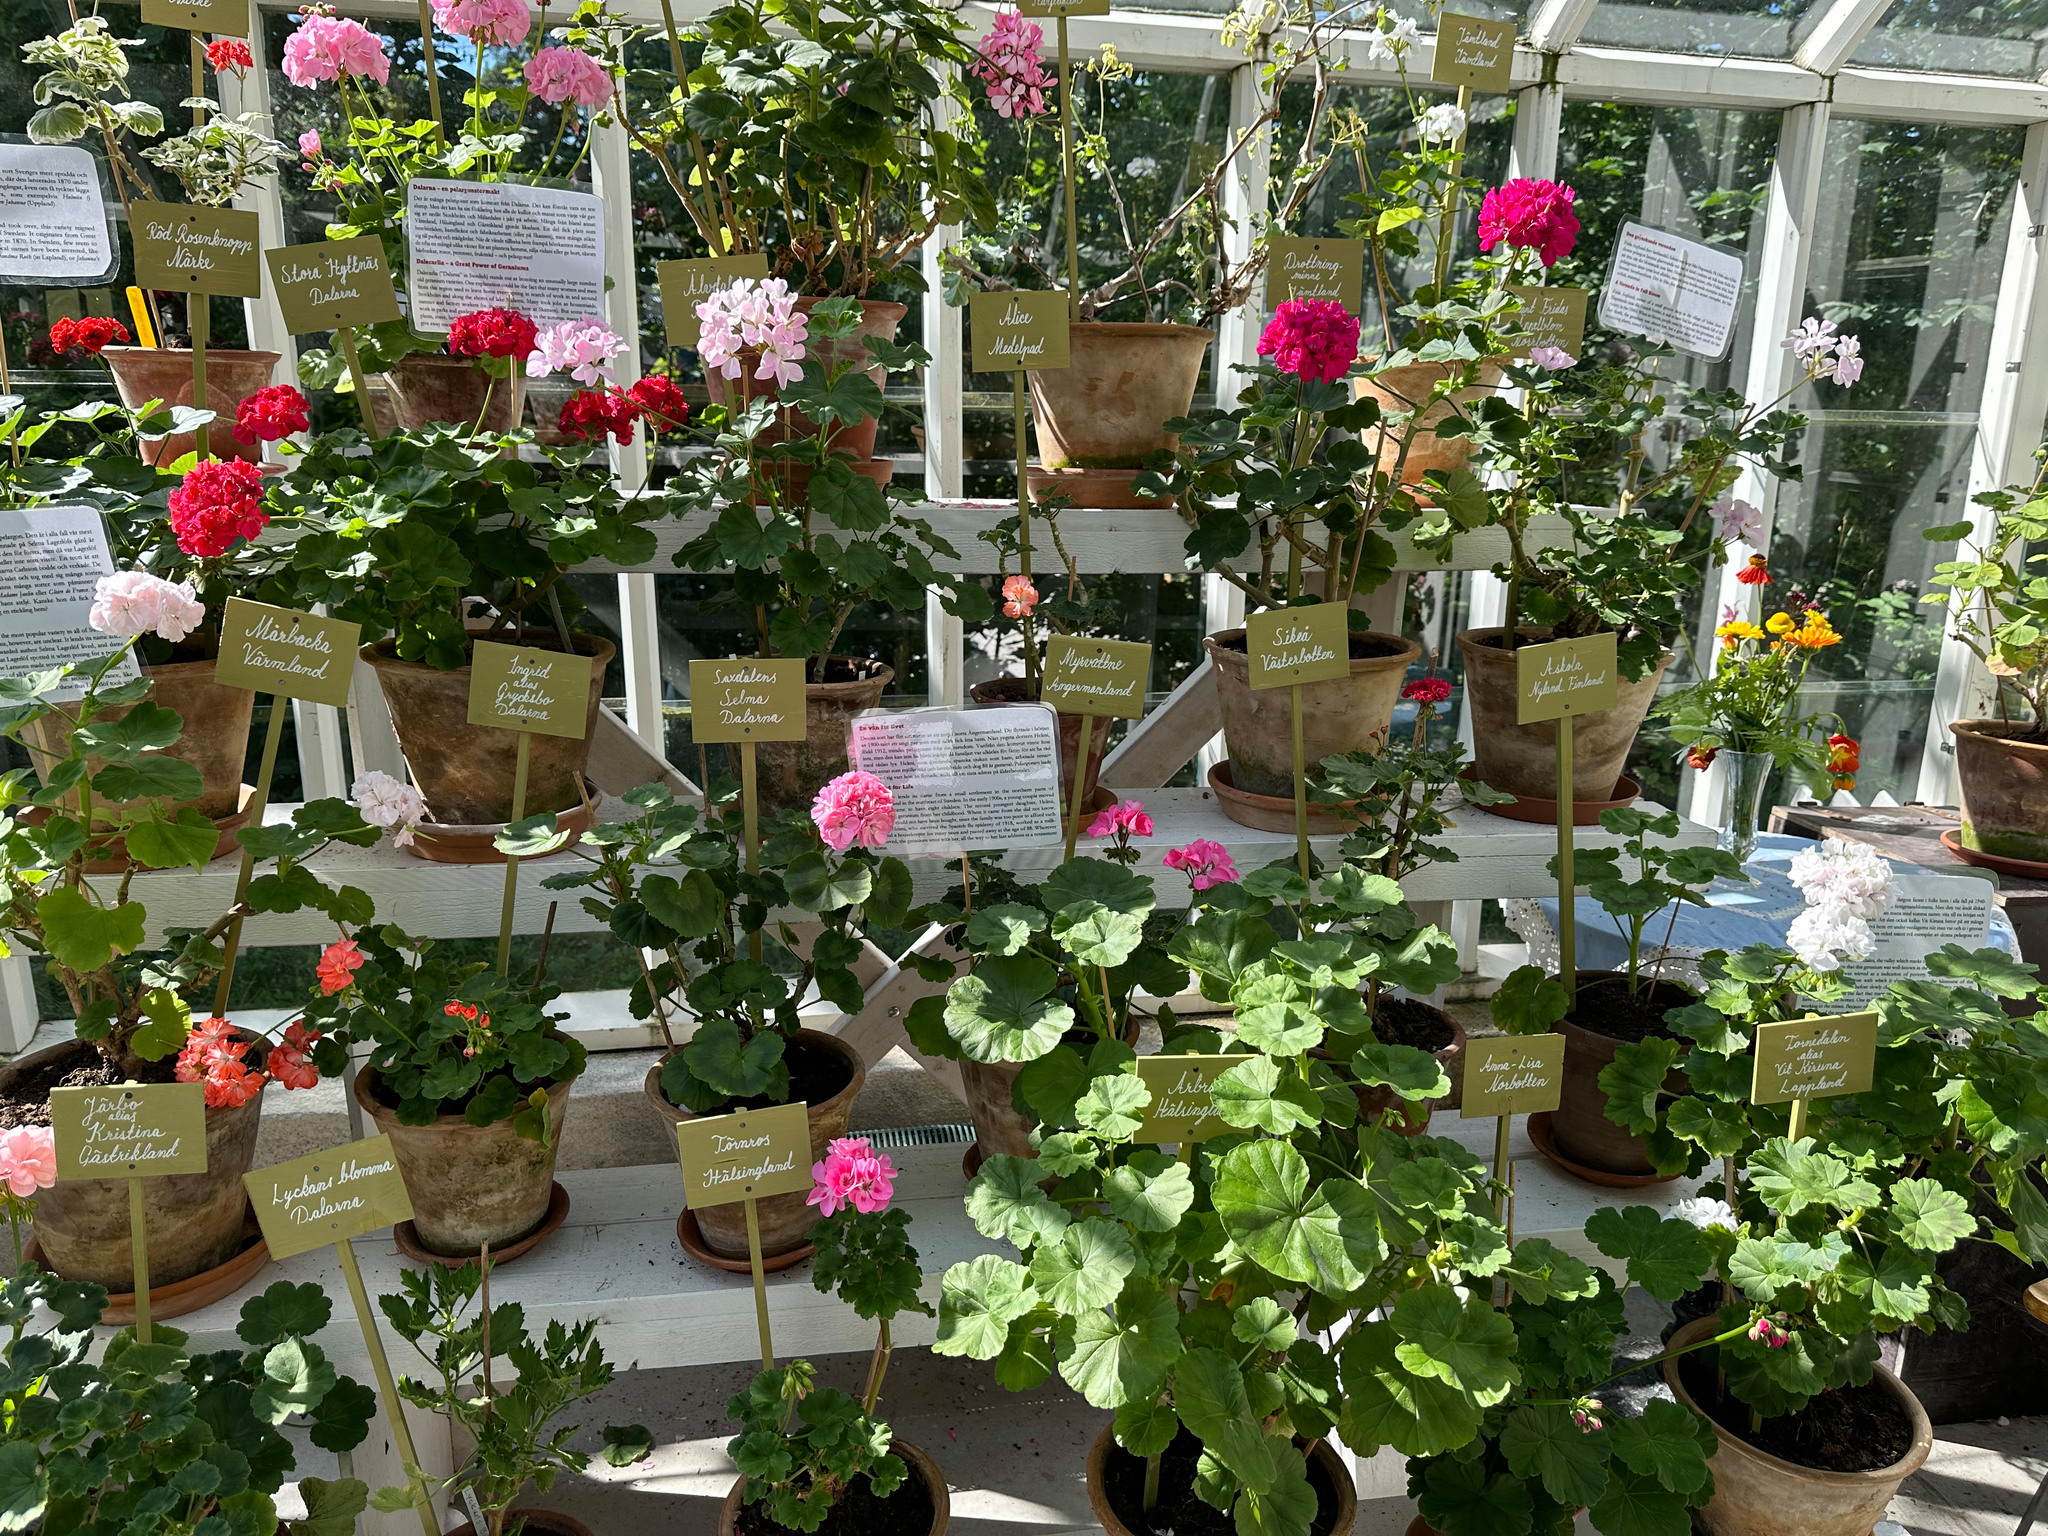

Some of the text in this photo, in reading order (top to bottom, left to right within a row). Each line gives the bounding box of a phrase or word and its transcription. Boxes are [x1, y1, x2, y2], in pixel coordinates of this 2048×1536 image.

[1456, 27, 1502, 48] Jämtland
[1454, 48, 1498, 67] Jämtland
[146, 222, 253, 255] Röd Rosenknopp
[167, 246, 215, 270] Närke
[1284, 252, 1343, 280] Drottning-
[282, 255, 378, 285] Stora Hyttnäs
[1291, 270, 1320, 280] minne
[684, 269, 733, 296] Älvdal
[310, 286, 360, 306] Dalarna
[1540, 298, 1568, 315] Fridas
[1000, 303, 1033, 326] Alice
[988, 335, 1044, 361] Medelpad
[1511, 333, 1568, 348] Norrbotten
[245, 614, 332, 654] Mårbacka
[1273, 626, 1313, 646] Sikeå
[57, 643, 79, 651] Lagerlöf
[70, 650, 91, 658] posing
[1261, 645, 1335, 671] Västerbotten
[242, 642, 330, 680] Värmland
[507, 655, 552, 683] Ingrid
[1540, 654, 1583, 677] Askola
[513, 678, 538, 690] alias
[714, 668, 776, 684] Saxdalens
[1047, 670, 1136, 698] Ångermanland
[1568, 670, 1606, 690] Finland
[496, 682, 554, 707] Grycksbo
[720, 688, 770, 706] Selma
[494, 703, 551, 720] Dalarna
[720, 708, 785, 724] Dalarna
[1785, 1030, 1850, 1051] Tornedalen
[1797, 1049, 1823, 1060] alias
[1775, 1060, 1844, 1076] Vit Kiruna
[1168, 1071, 1214, 1094] Arbr
[1780, 1071, 1848, 1097] Lappland
[82, 1093, 143, 1126] Järbo
[108, 1110, 137, 1122] alias
[1153, 1098, 1221, 1125] Hälsingla
[86, 1122, 166, 1143] Kristina
[711, 1134, 770, 1154] Törnros
[78, 1138, 181, 1167] Gästrikland
[703, 1150, 795, 1188] Hälsingland
[273, 1160, 394, 1210] Lyckans blomma
[290, 1196, 365, 1224] Dalarna
